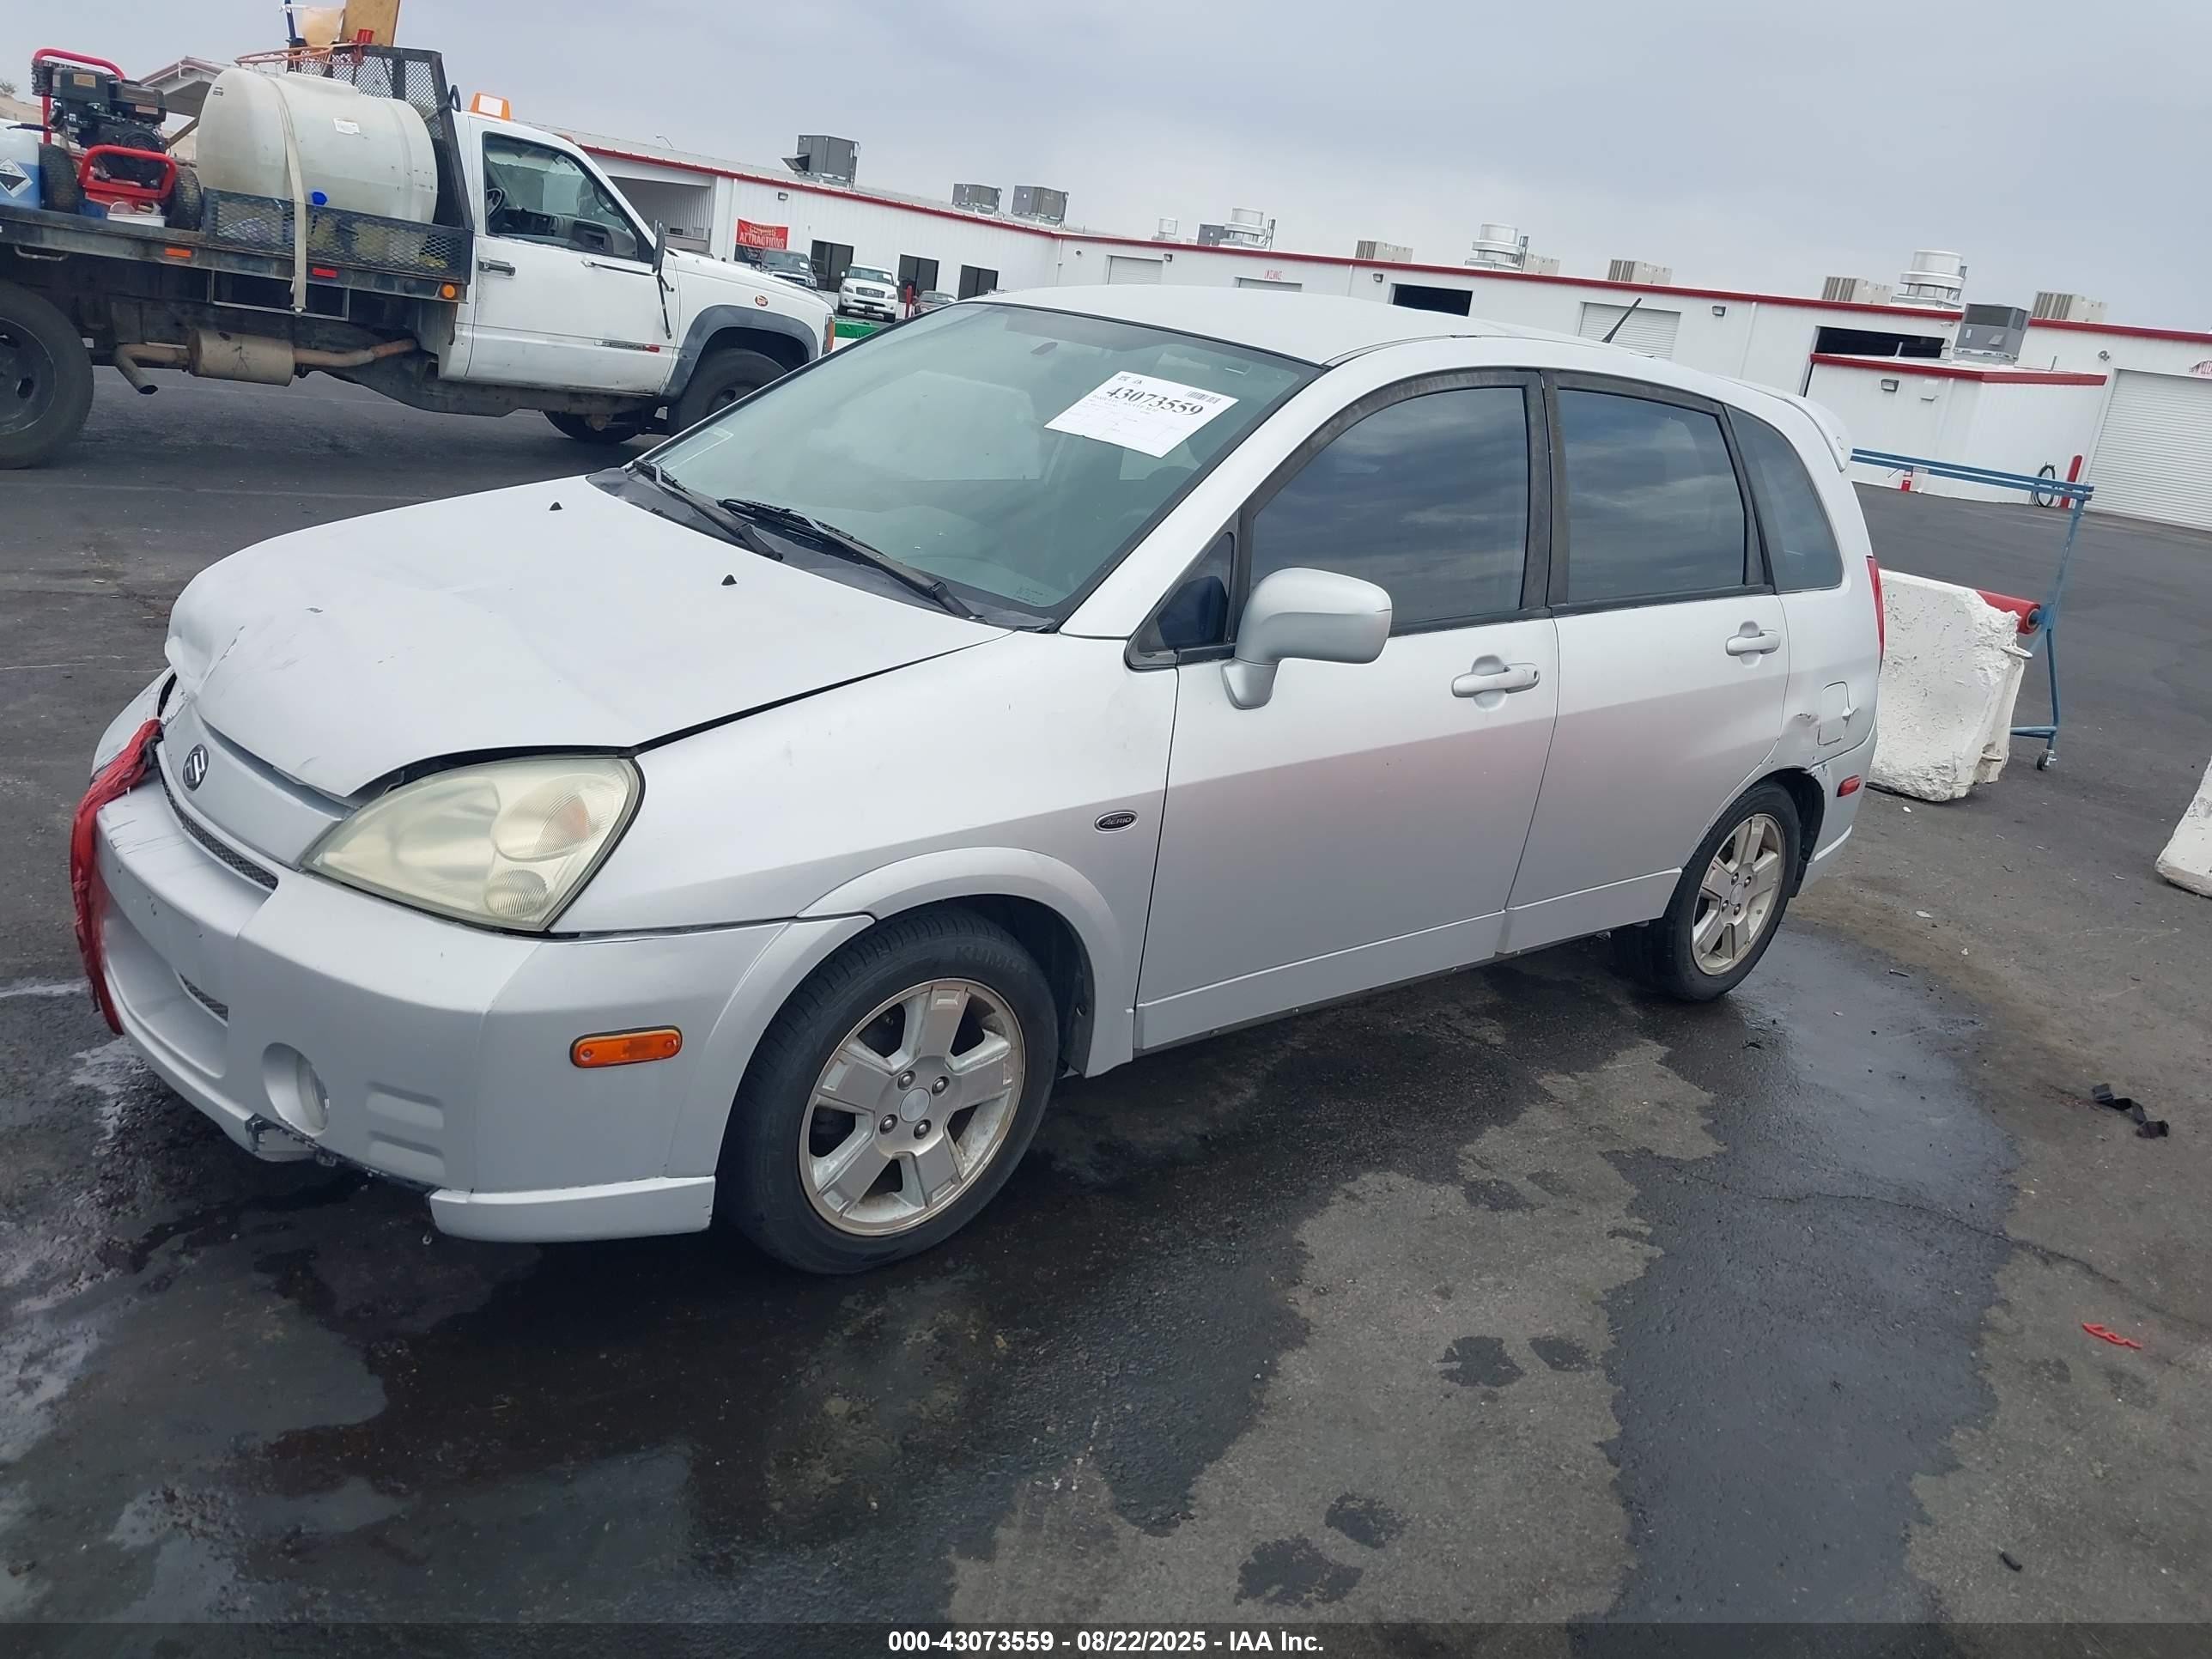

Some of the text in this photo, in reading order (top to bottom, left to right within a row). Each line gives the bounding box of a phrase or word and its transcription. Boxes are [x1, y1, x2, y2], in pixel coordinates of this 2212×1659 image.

[738, 231, 785, 249] ATTRACTIONS
[1106, 386, 1204, 416] 43073559
[1101, 817, 1132, 827] AERIO
